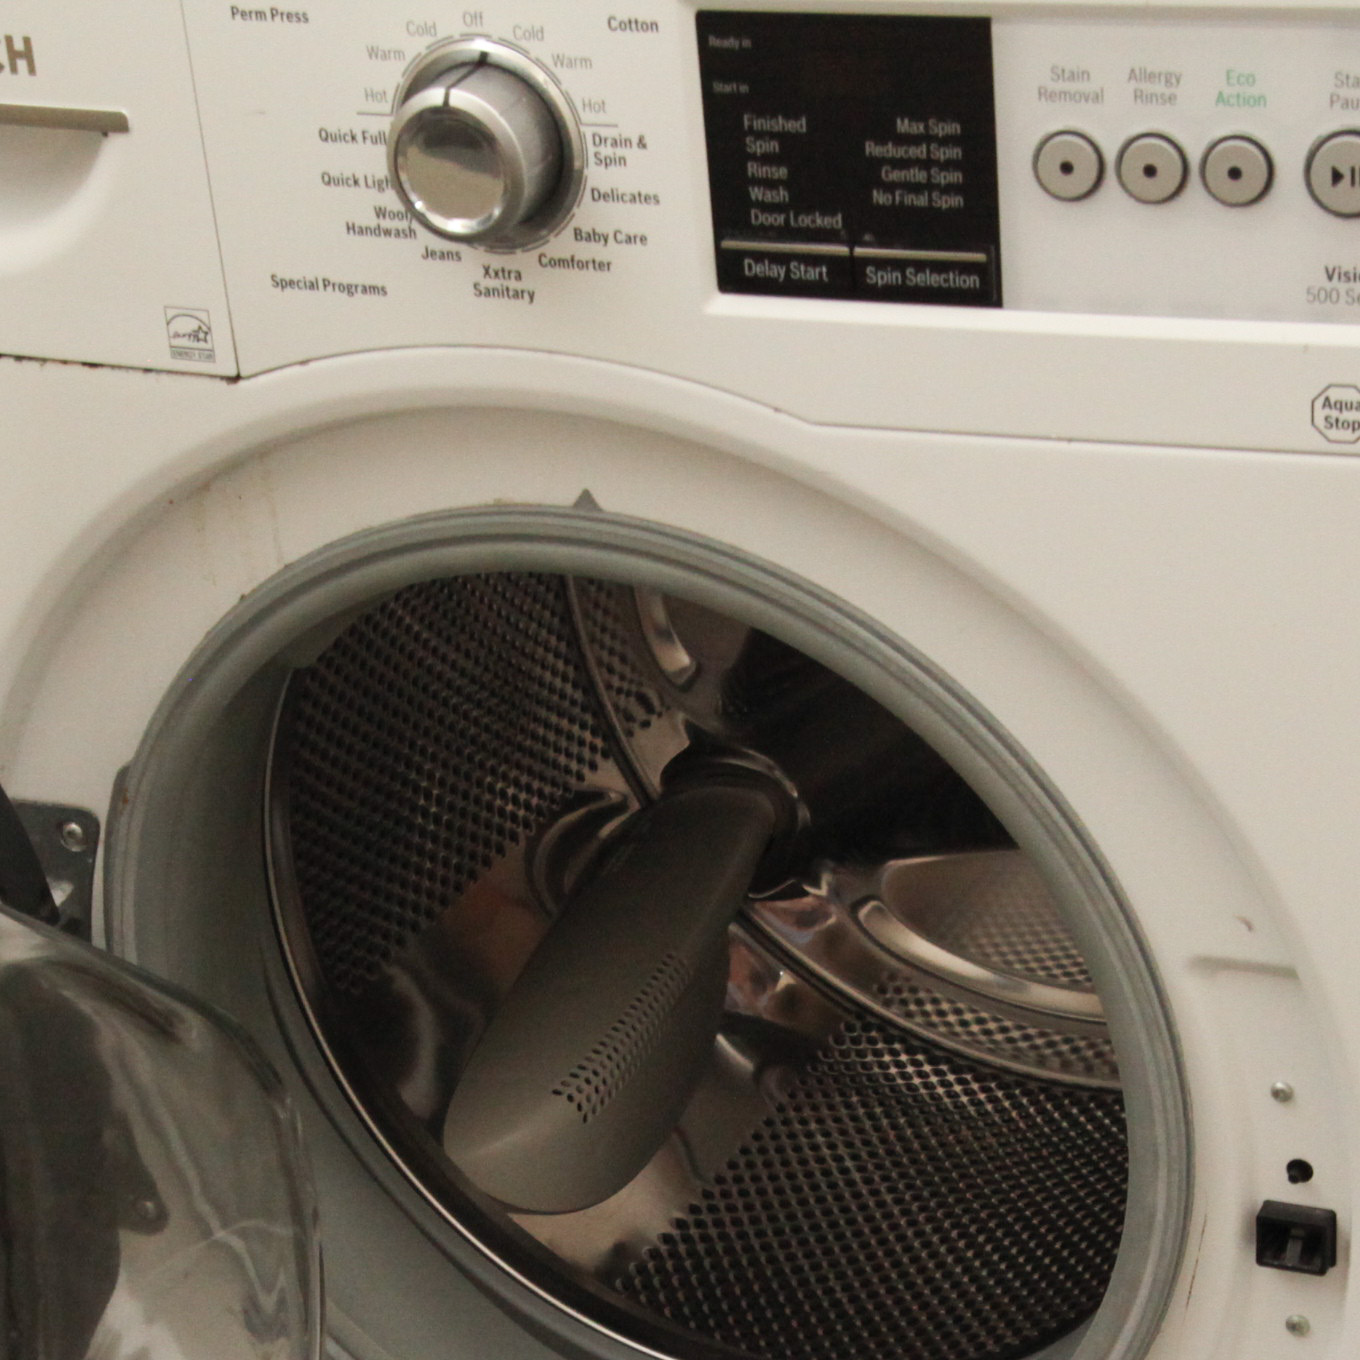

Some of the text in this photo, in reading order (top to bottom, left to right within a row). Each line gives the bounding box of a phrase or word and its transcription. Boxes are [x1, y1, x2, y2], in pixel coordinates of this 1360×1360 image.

[230, 5, 309, 24] Perm Press
[462, 11, 484, 28] Off
[406, 19, 437, 37] Cold
[512, 24, 544, 42] Cold
[607, 15, 659, 33] Cotton
[709, 35, 739, 50] Ready
[366, 45, 405, 62] Warm
[551, 52, 592, 70] Warm
[1050, 65, 1090, 83] Stain
[1128, 67, 1181, 88] Allergy
[1226, 69, 1256, 87] Eco
[363, 87, 388, 104] Hot
[1038, 87, 1104, 105] Removal
[1134, 88, 1177, 106] Rinse
[1215, 90, 1267, 108] Action
[581, 97, 607, 114] Hot
[744, 113, 806, 133] Finished
[897, 117, 961, 138] Max Spin
[319, 128, 387, 146] Quick Full
[592, 132, 648, 150] Drain &
[746, 136, 779, 156] Spin
[594, 152, 627, 169] Spin
[865, 141, 962, 162] Reduced Spin
[747, 161, 789, 180] Rinse
[882, 166, 963, 187] Gentle Spin
[321, 171, 390, 193] Quick Lig
[591, 187, 660, 205] Delicates
[749, 186, 789, 203] Wash
[873, 189, 964, 210] No Final Spin
[751, 209, 842, 229] Door Locked
[346, 221, 417, 239] Handwash
[573, 227, 648, 246] Baby Care
[421, 246, 461, 262] Jeans
[538, 252, 612, 272] Comforter
[483, 264, 522, 281] Xxtra
[743, 258, 829, 282] Delay Start
[866, 266, 981, 288] Spin Selection
[271, 274, 387, 297] Special Programs
[473, 282, 535, 303] Sanitary
[1306, 285, 1340, 305] 500
